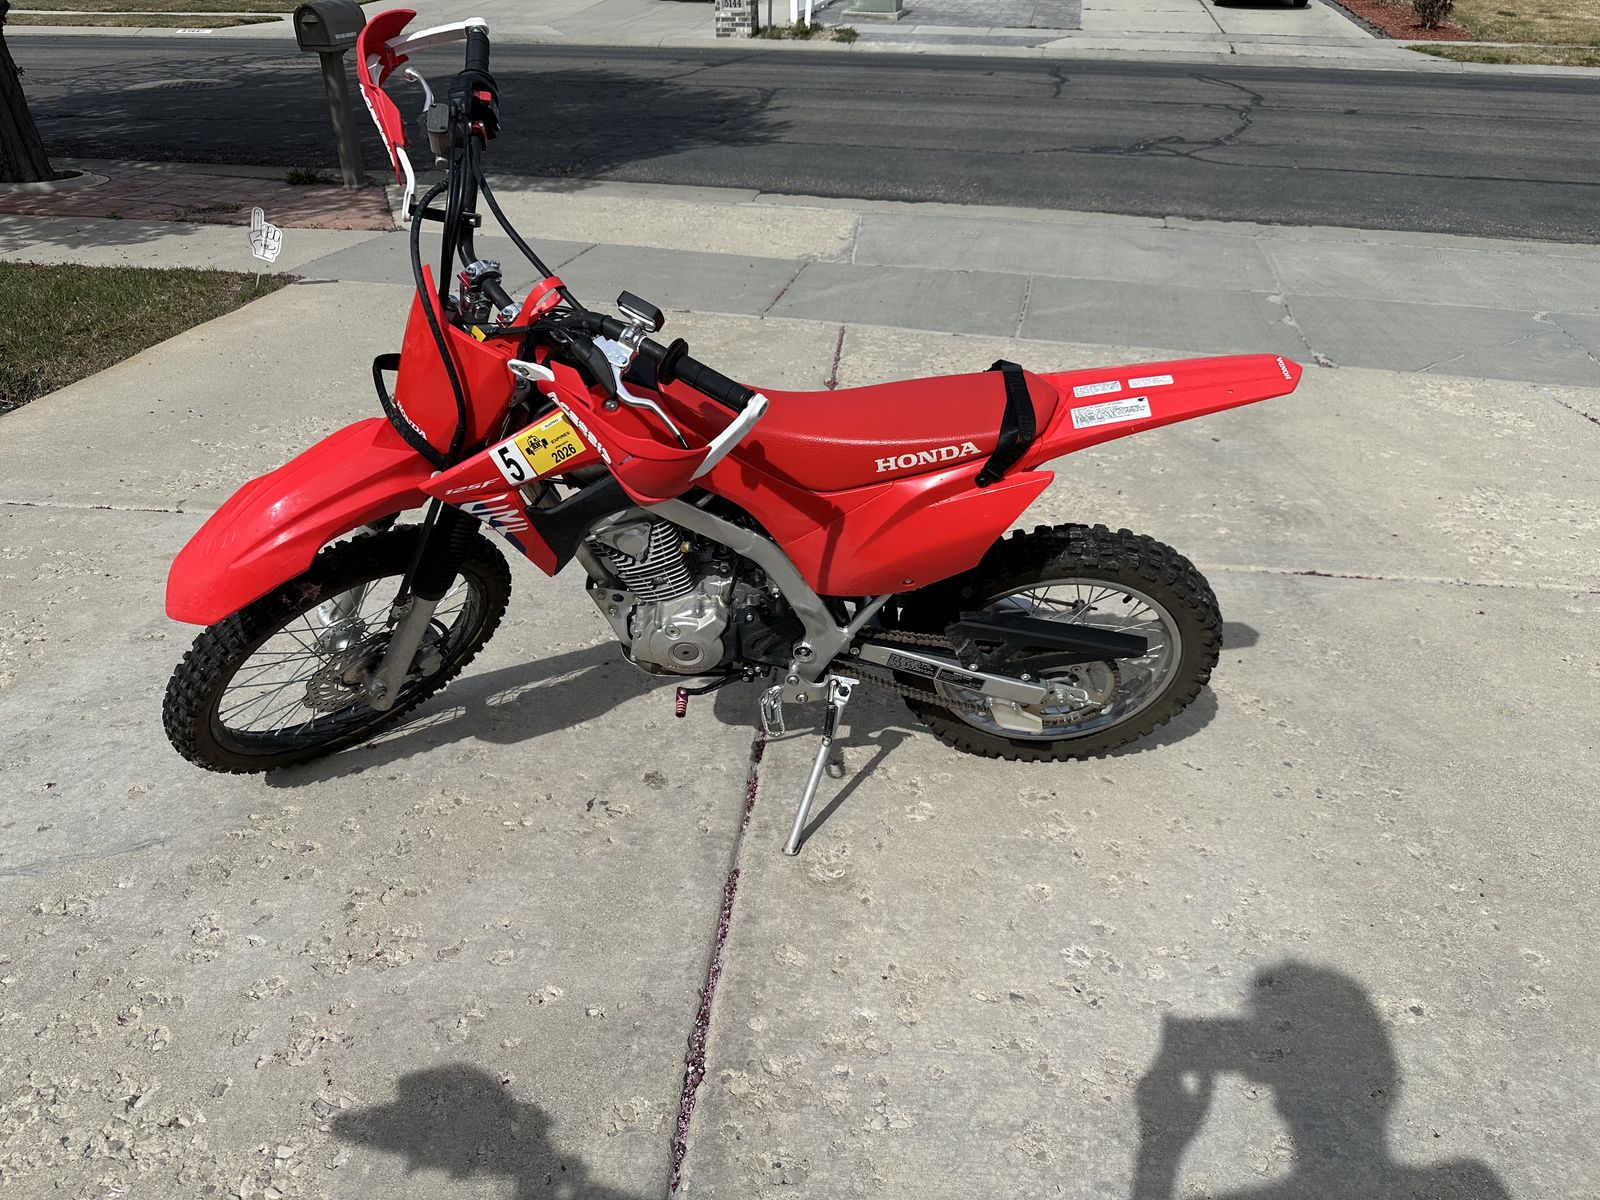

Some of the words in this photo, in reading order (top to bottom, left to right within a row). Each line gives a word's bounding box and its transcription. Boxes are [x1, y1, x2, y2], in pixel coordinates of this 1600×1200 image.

[1276, 357, 1292, 380] HONDA
[497, 446, 526, 482] 5
[551, 443, 577, 464] 2026
[874, 441, 982, 473] HONDA
